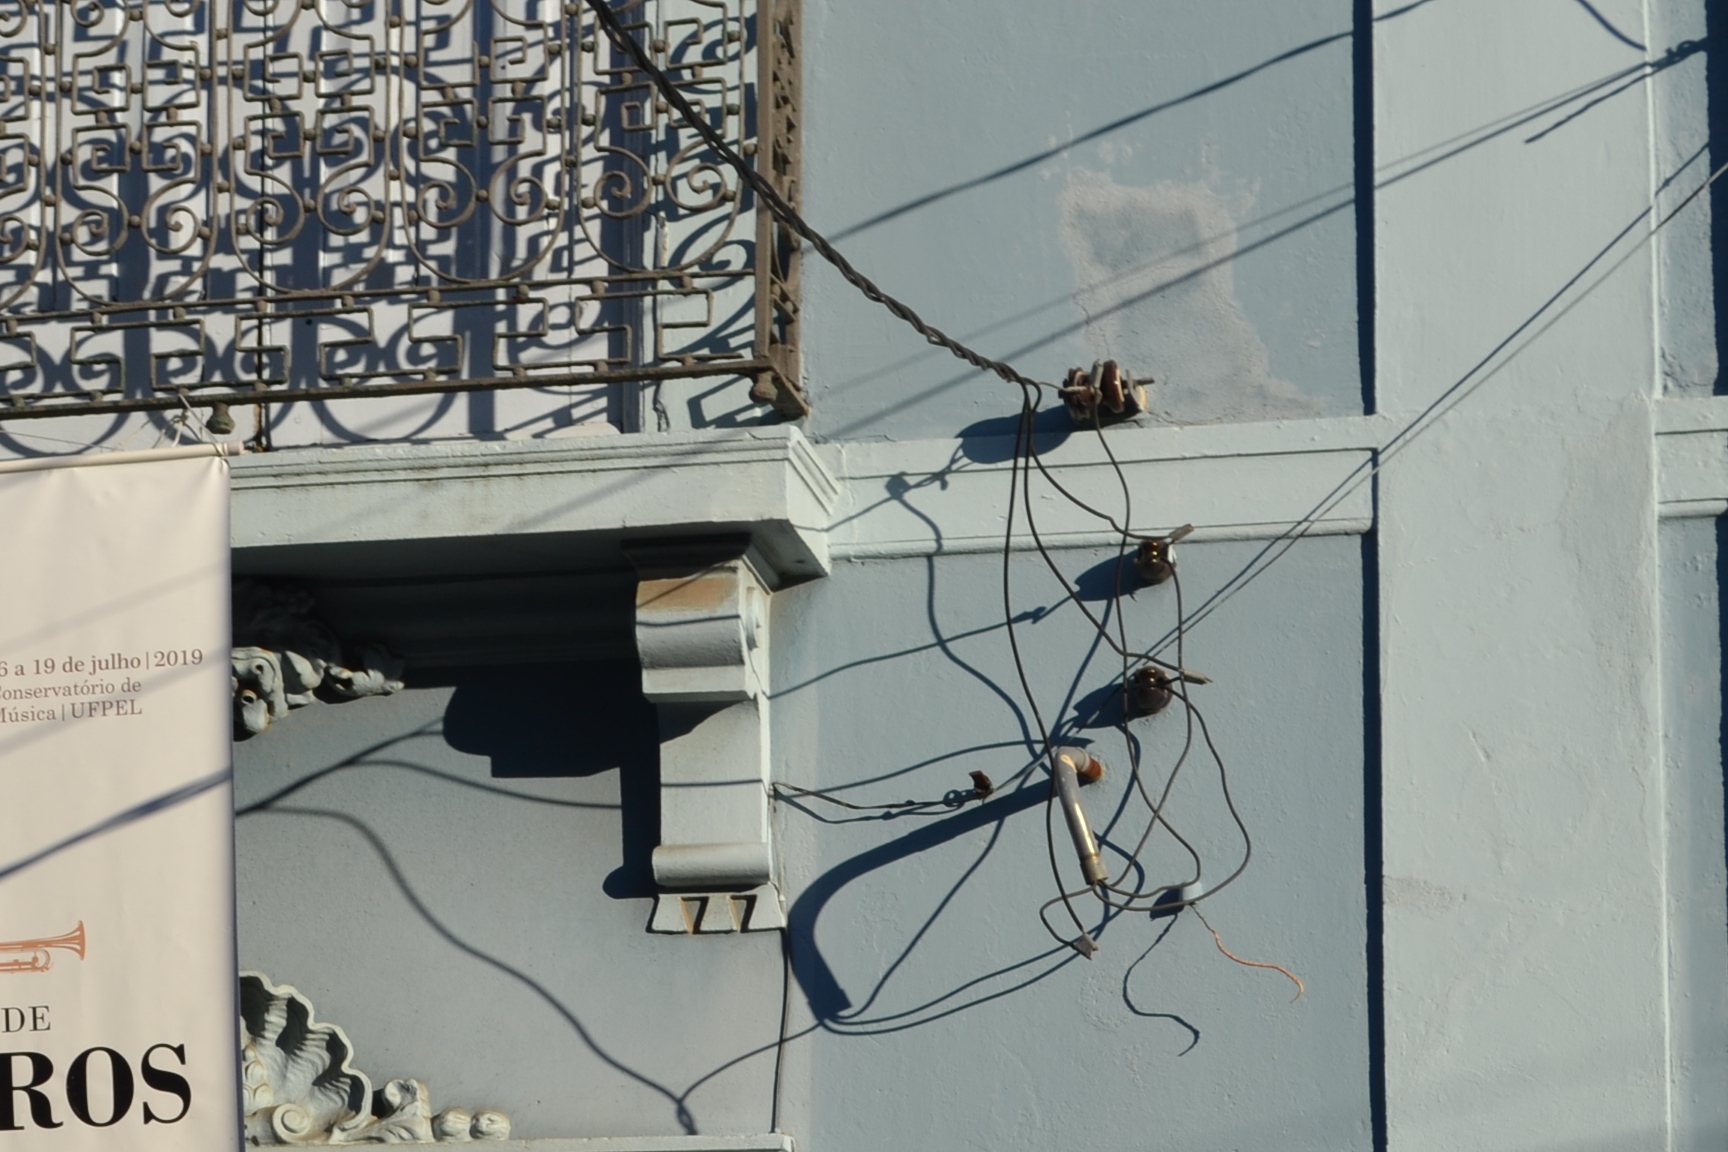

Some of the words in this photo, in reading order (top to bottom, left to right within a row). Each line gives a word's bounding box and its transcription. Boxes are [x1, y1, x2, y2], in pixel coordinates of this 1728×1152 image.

[14, 664, 25, 677] a
[34, 657, 55, 675] 19
[62, 656, 85, 674] de
[89, 653, 141, 676] julho
[154, 649, 203, 668] 2019
[121, 677, 142, 693] de
[71, 698, 143, 719] UFPEL
[1, 1005, 52, 1034] DE
